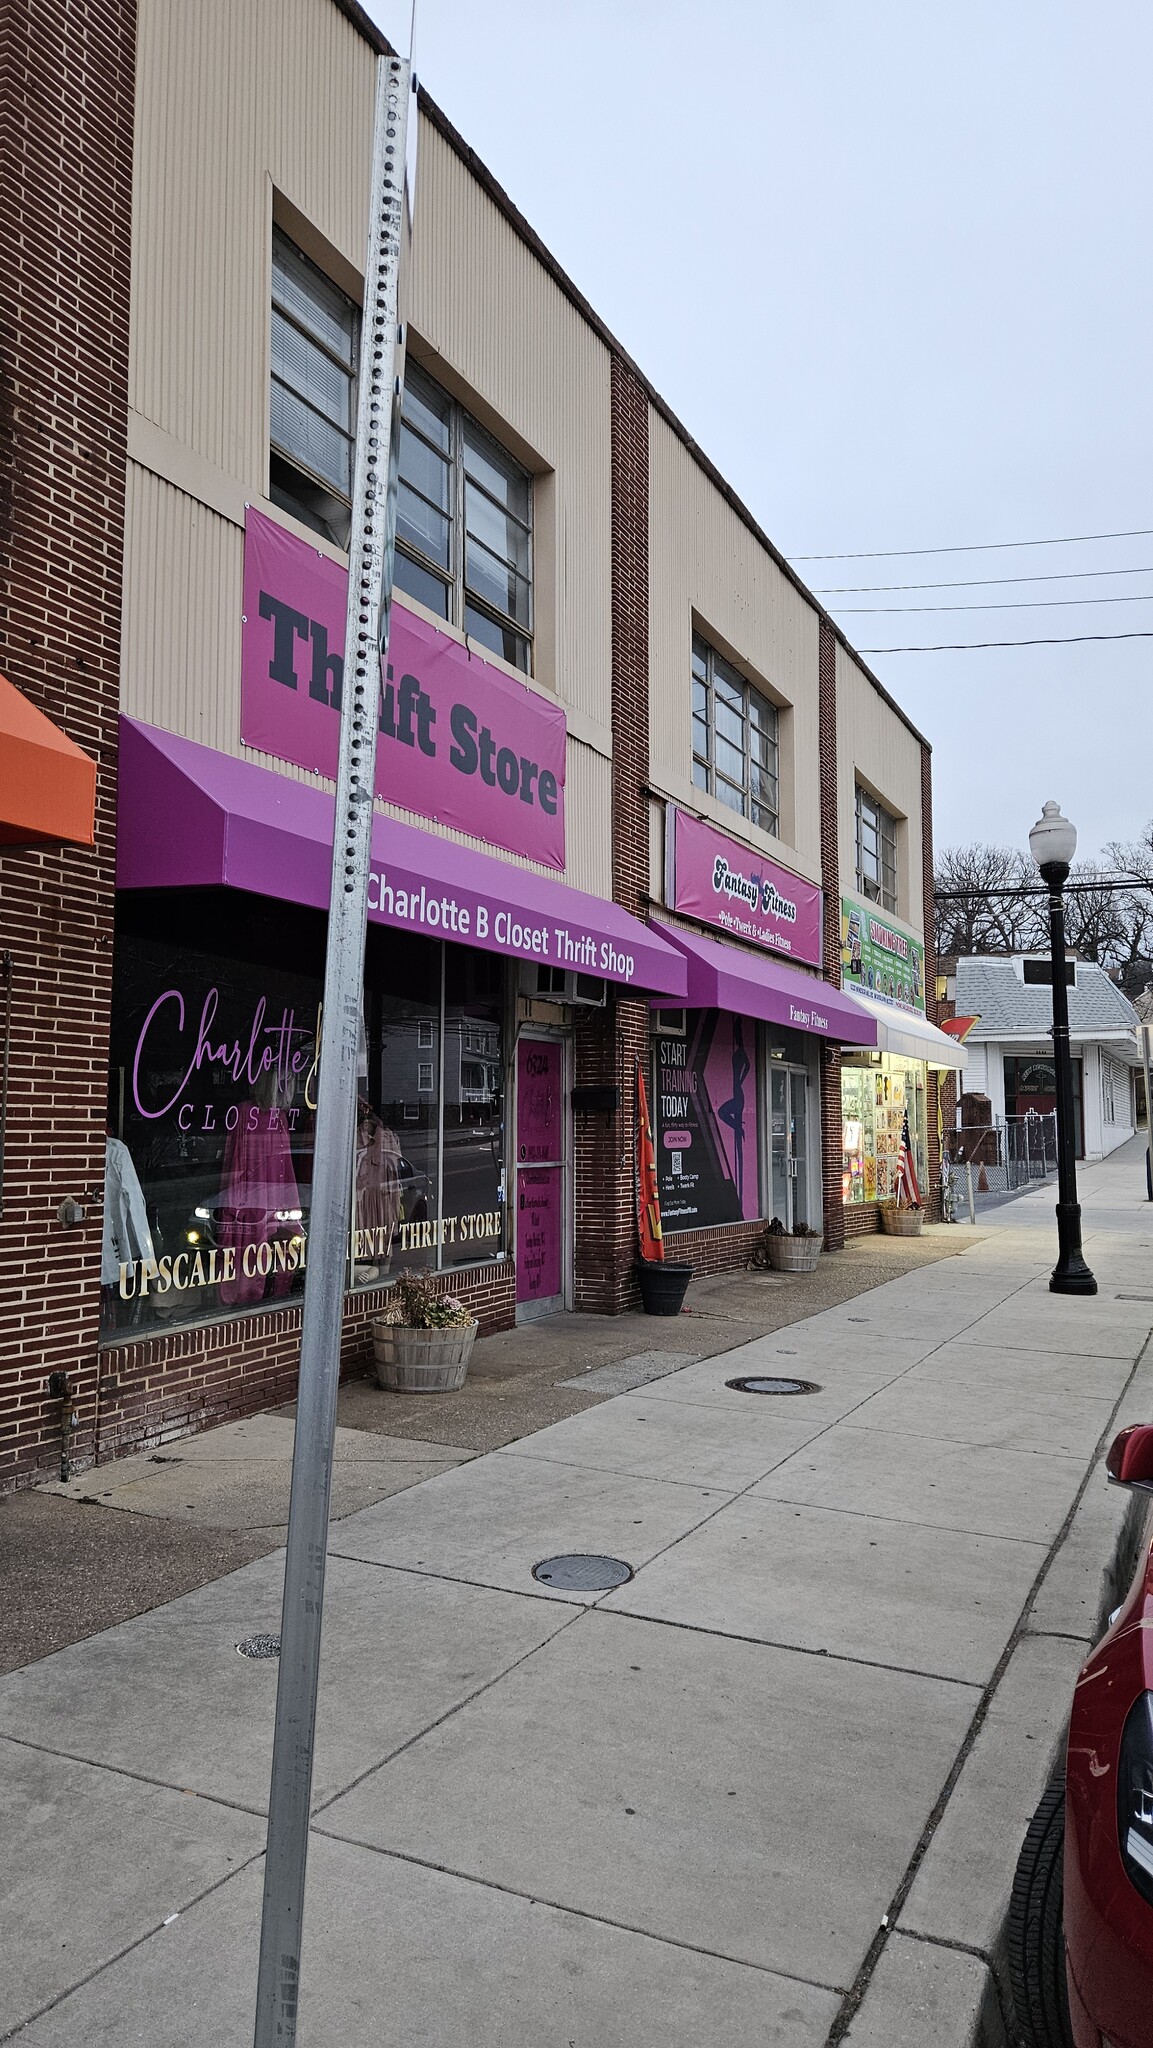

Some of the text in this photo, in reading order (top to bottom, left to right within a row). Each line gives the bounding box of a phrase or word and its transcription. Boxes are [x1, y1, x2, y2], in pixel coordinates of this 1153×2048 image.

[259, 589, 557, 815] Thift Store
[713, 857, 796, 922] Fantasy Fitness
[367, 872, 634, 981] Charlotte B Closet Thrift Shop
[735, 916, 752, 937] Twerk
[759, 926, 775, 945] Ladies
[775, 932, 791, 951] Fitness
[790, 1004, 829, 1030] Fantasy Fitness
[133, 987, 314, 1118] Charlotte
[660, 1041, 687, 1066] START
[661, 1068, 697, 1093] TRAINING
[178, 1104, 300, 1131] CLOSET
[661, 1095, 689, 1117] TODAY
[118, 1247, 236, 1300] UPSCALE
[400, 1216, 458, 1251] THRIFT
[460, 1211, 501, 1241] STORE
